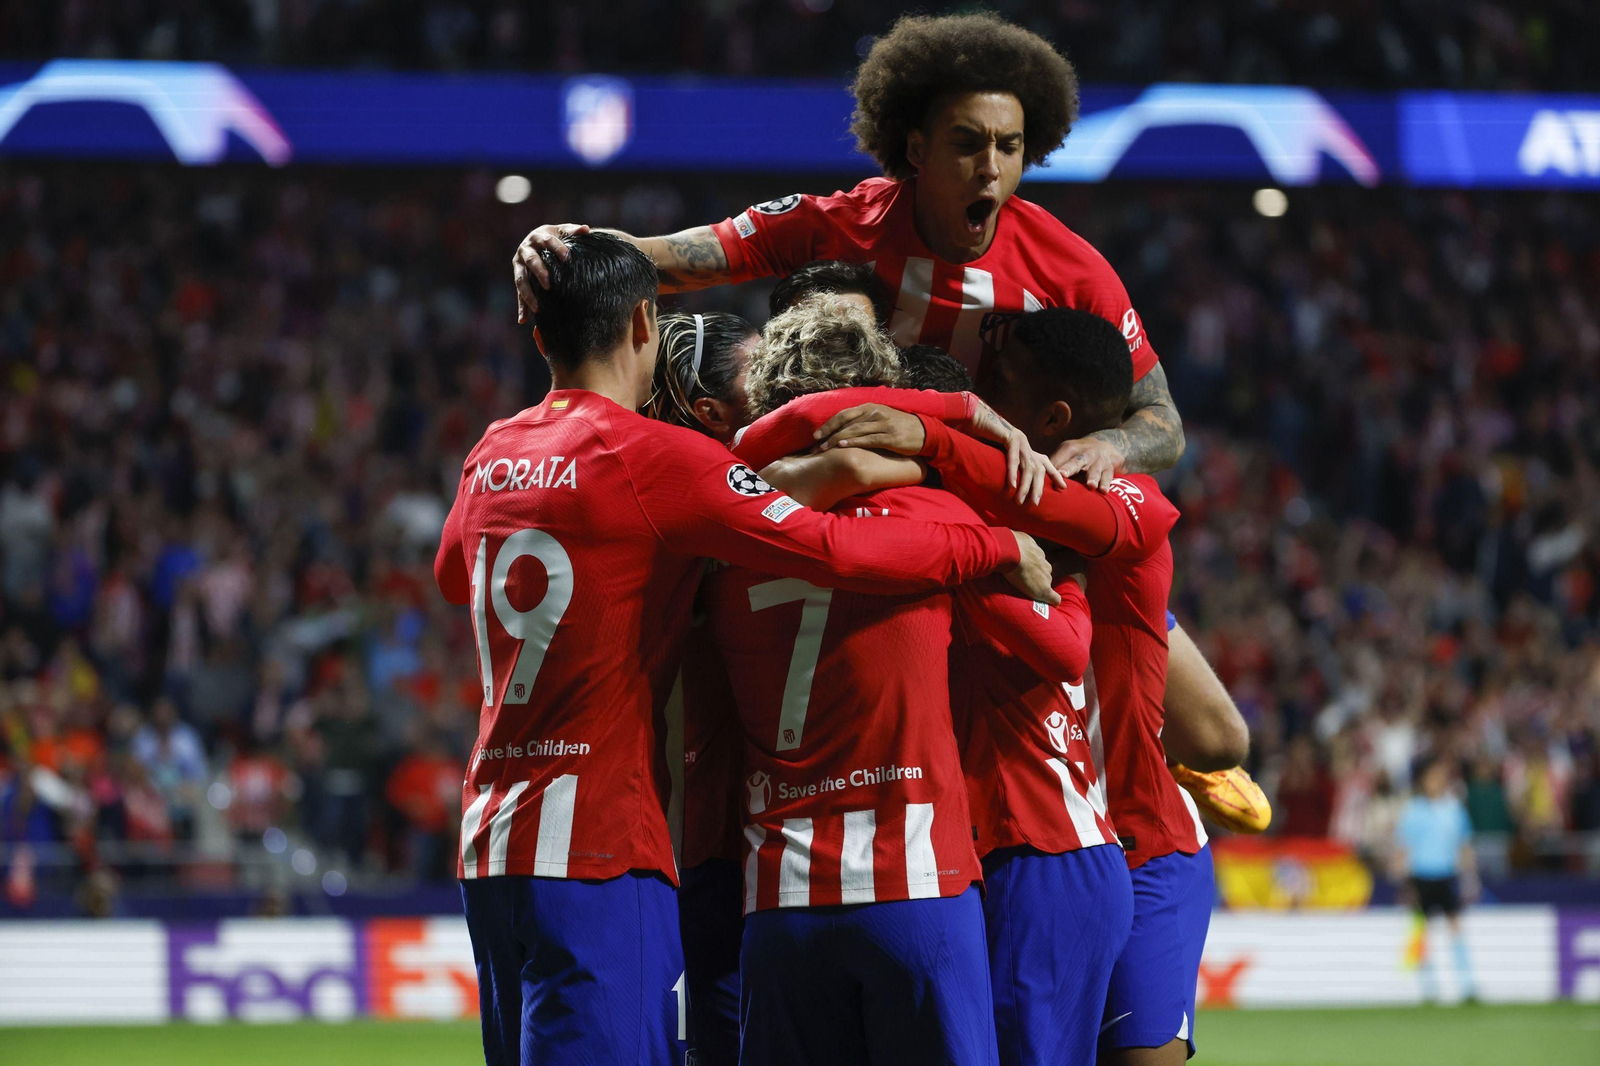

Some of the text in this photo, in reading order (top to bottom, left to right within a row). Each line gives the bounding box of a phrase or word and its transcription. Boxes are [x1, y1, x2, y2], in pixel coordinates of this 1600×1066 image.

[470, 456, 578, 495] MORATA
[471, 528, 575, 707] 19
[747, 577, 834, 751] 7
[526, 739, 591, 757] Children
[778, 764, 923, 800] Save the Children
[671, 970, 687, 1040] 1
